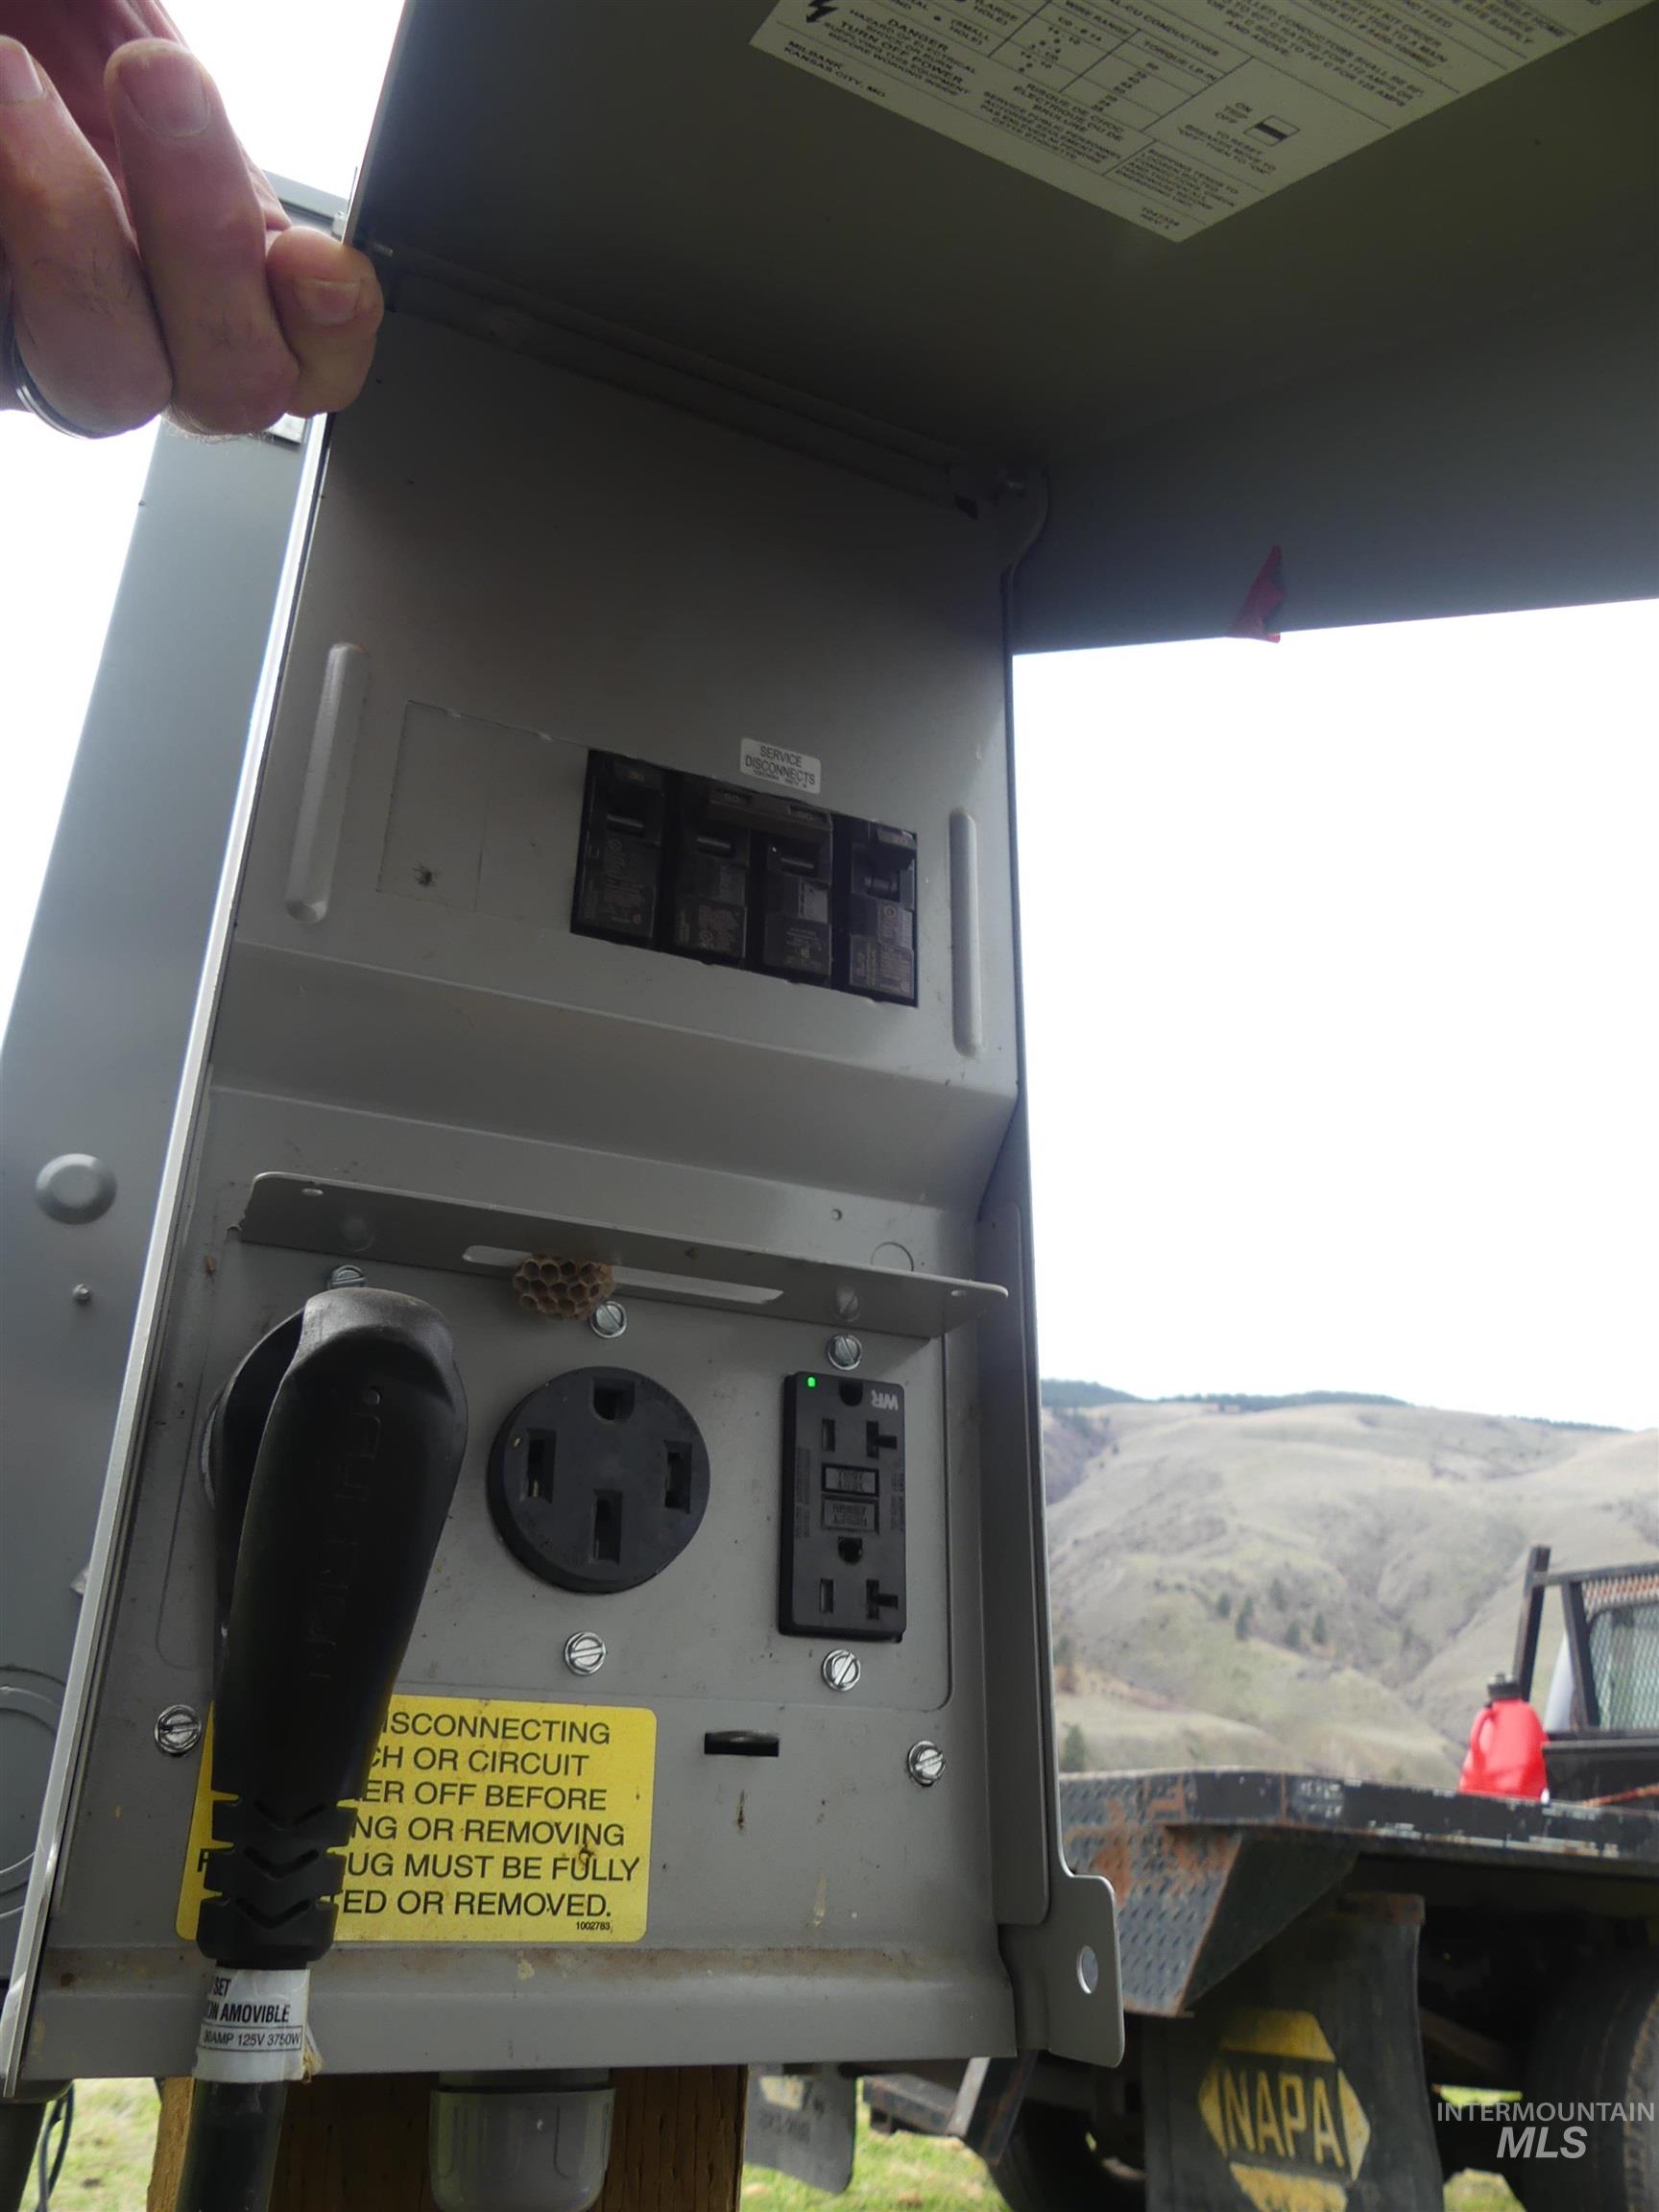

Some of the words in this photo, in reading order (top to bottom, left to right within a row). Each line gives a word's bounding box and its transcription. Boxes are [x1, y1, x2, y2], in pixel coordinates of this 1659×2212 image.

[850, 10, 891, 32] HAZARD
[914, 40, 974, 73] ELECTRICAL
[888, 19, 948, 51] DANGER
[1144, 15, 1218, 56] CONDUCTORS
[1225, 20, 1249, 34] AND
[1279, 15, 1353, 57] CONDUCTORS
[788, 41, 842, 68] MILBANK
[829, 32, 870, 53] BEFORE
[874, 54, 922, 79] WORKING
[842, 21, 878, 42] TURN
[881, 41, 908, 55] OFF
[912, 57, 962, 83] POWER
[866, 25, 902, 45] SHOCK
[924, 53, 952, 69] BURN
[784, 47, 831, 72] KANSAS
[867, 85, 885, 97] MO
[911, 64, 969, 93] EQUIPMENT
[1026, 84, 1069, 106] RISQUE
[1235, 102, 1252, 112] ON
[983, 91, 1025, 112] SERVICE
[1066, 131, 1120, 158] PERSONNEL
[1214, 112, 1237, 123] OFF
[1224, 106, 1247, 118] TRIP
[1186, 124, 1231, 148] BREAKER
[1234, 148, 1260, 162] MOVE
[1207, 142, 1231, 156] THEN
[745, 754, 816, 785] DISCONNECTS
[760, 745, 803, 768] SERVICE
[872, 1389, 899, 1410] WR
[383, 1712, 610, 1744] ISCONNECTING
[414, 1747, 458, 1771] OR
[469, 1749, 589, 1776] CIRCUIT
[415, 1781, 477, 1806] OFF
[485, 1784, 607, 1811] BEFORE
[408, 1816, 453, 1841] OR
[464, 1818, 624, 1847] REMOVING
[348, 1852, 394, 1877] UG
[404, 1853, 493, 1879] MUST
[502, 1856, 541, 1880] BE
[552, 1857, 640, 1882] FULLY
[397, 1889, 444, 1915] OR
[454, 1891, 612, 1917] REMOVED.
[576, 1921, 611, 1932] 1002783
[213, 1977, 231, 1997] SET
[221, 2003, 291, 2024] AMOVIBLE
[238, 2032, 266, 2047] 125V
[267, 2032, 301, 2047] 3750W
[1222, 2069, 1345, 2168] NAPA
